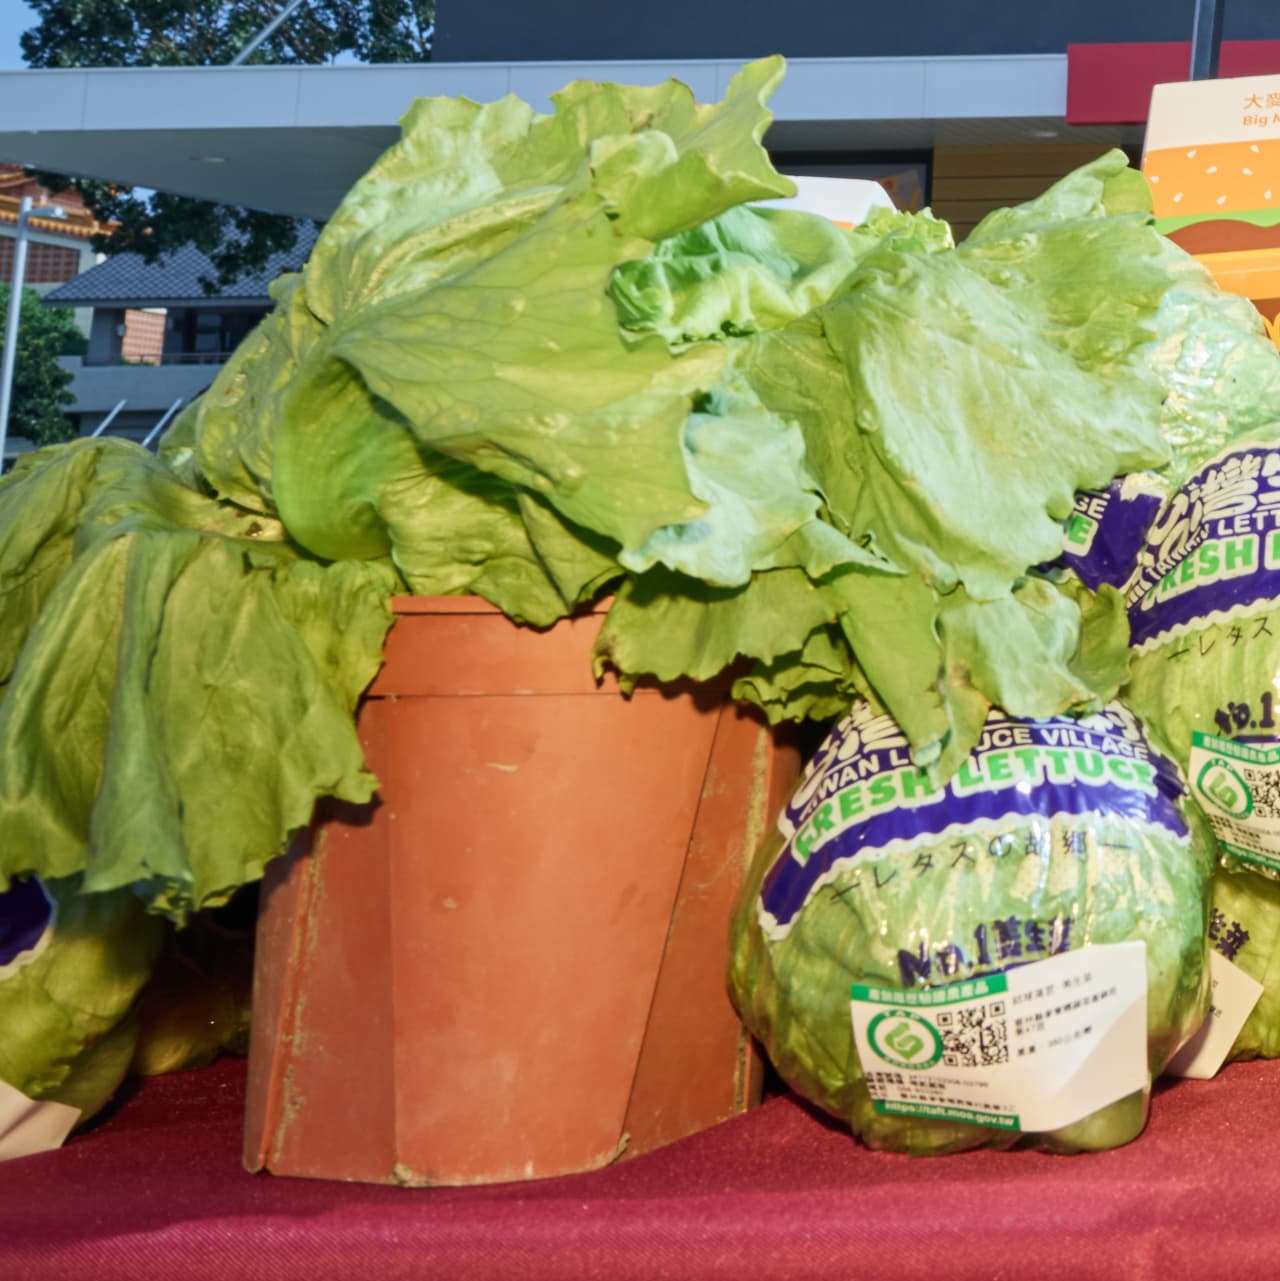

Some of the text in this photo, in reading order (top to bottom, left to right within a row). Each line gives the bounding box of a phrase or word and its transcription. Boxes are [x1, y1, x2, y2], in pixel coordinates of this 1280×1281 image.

[1243, 114, 1268, 127] Big
[1039, 727, 1149, 761] VILLAGE
[958, 748, 1156, 789] LETTUCE
